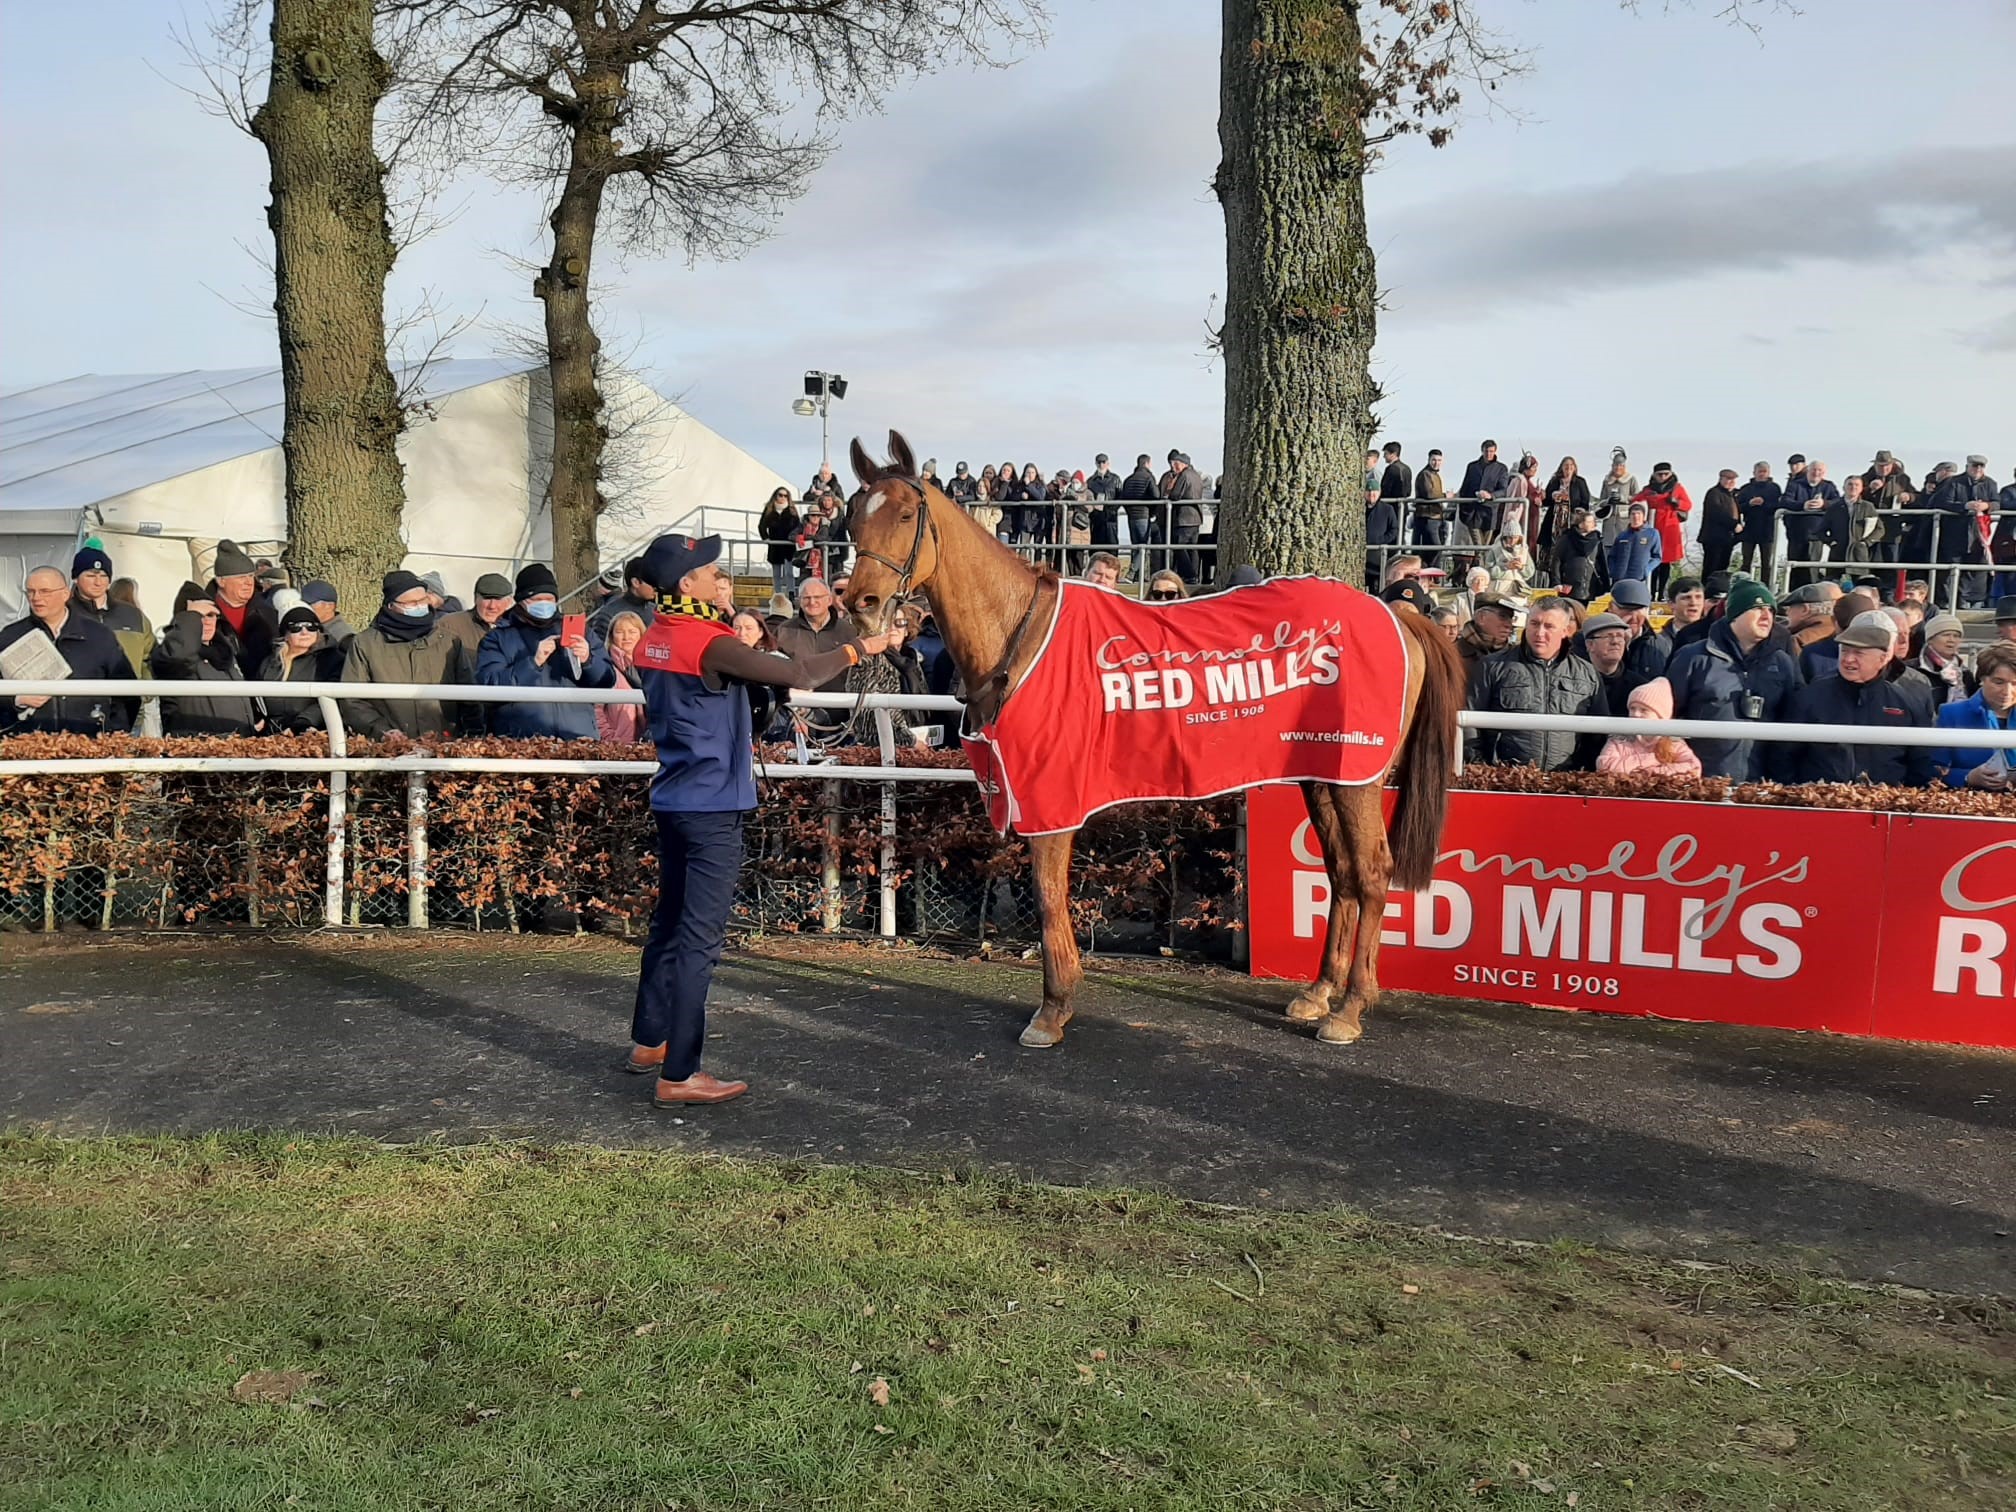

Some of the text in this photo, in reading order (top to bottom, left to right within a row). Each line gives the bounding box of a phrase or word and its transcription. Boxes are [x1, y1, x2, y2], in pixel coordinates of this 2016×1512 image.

[1096, 619, 1341, 672] Connolly's
[1101, 668, 1194, 713] RED
[1185, 704, 1265, 725] SINCE 1908
[1279, 730, 1385, 746] www.redmills.ie
[1290, 817, 1808, 940] Cnnolly's
[1454, 964, 1619, 995] SINCE 1908
